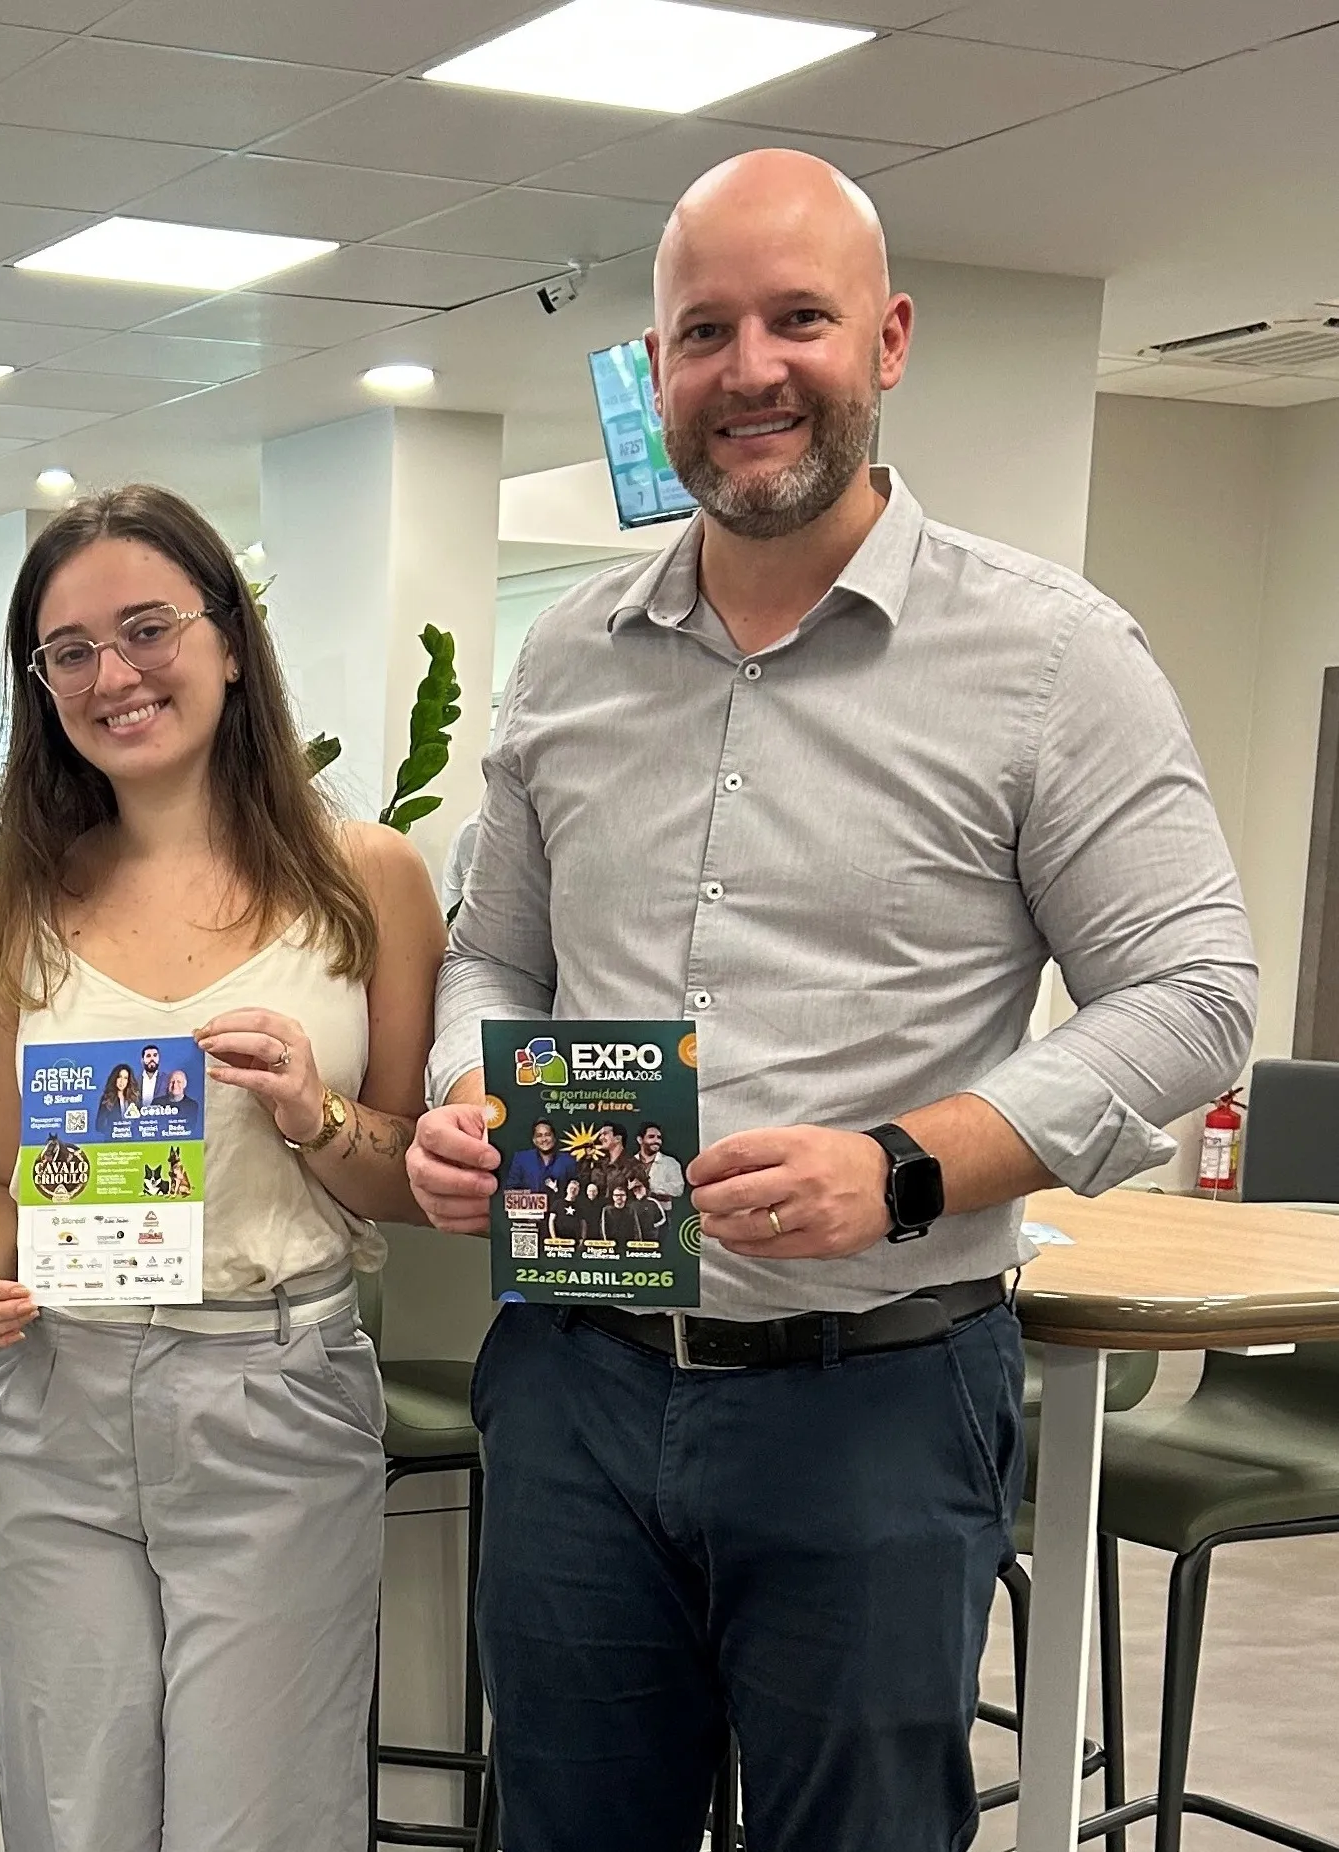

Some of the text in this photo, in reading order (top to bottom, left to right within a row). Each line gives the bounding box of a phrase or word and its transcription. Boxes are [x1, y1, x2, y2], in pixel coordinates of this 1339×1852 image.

[571, 1043, 663, 1070] EXPO
[35, 1066, 93, 1081] ARENA
[30, 1078, 97, 1092] DIGITAL
[34, 1160, 89, 1175] CAVALO
[34, 1173, 88, 1185] CRIOULO
[506, 1195, 546, 1210] SHOWS
